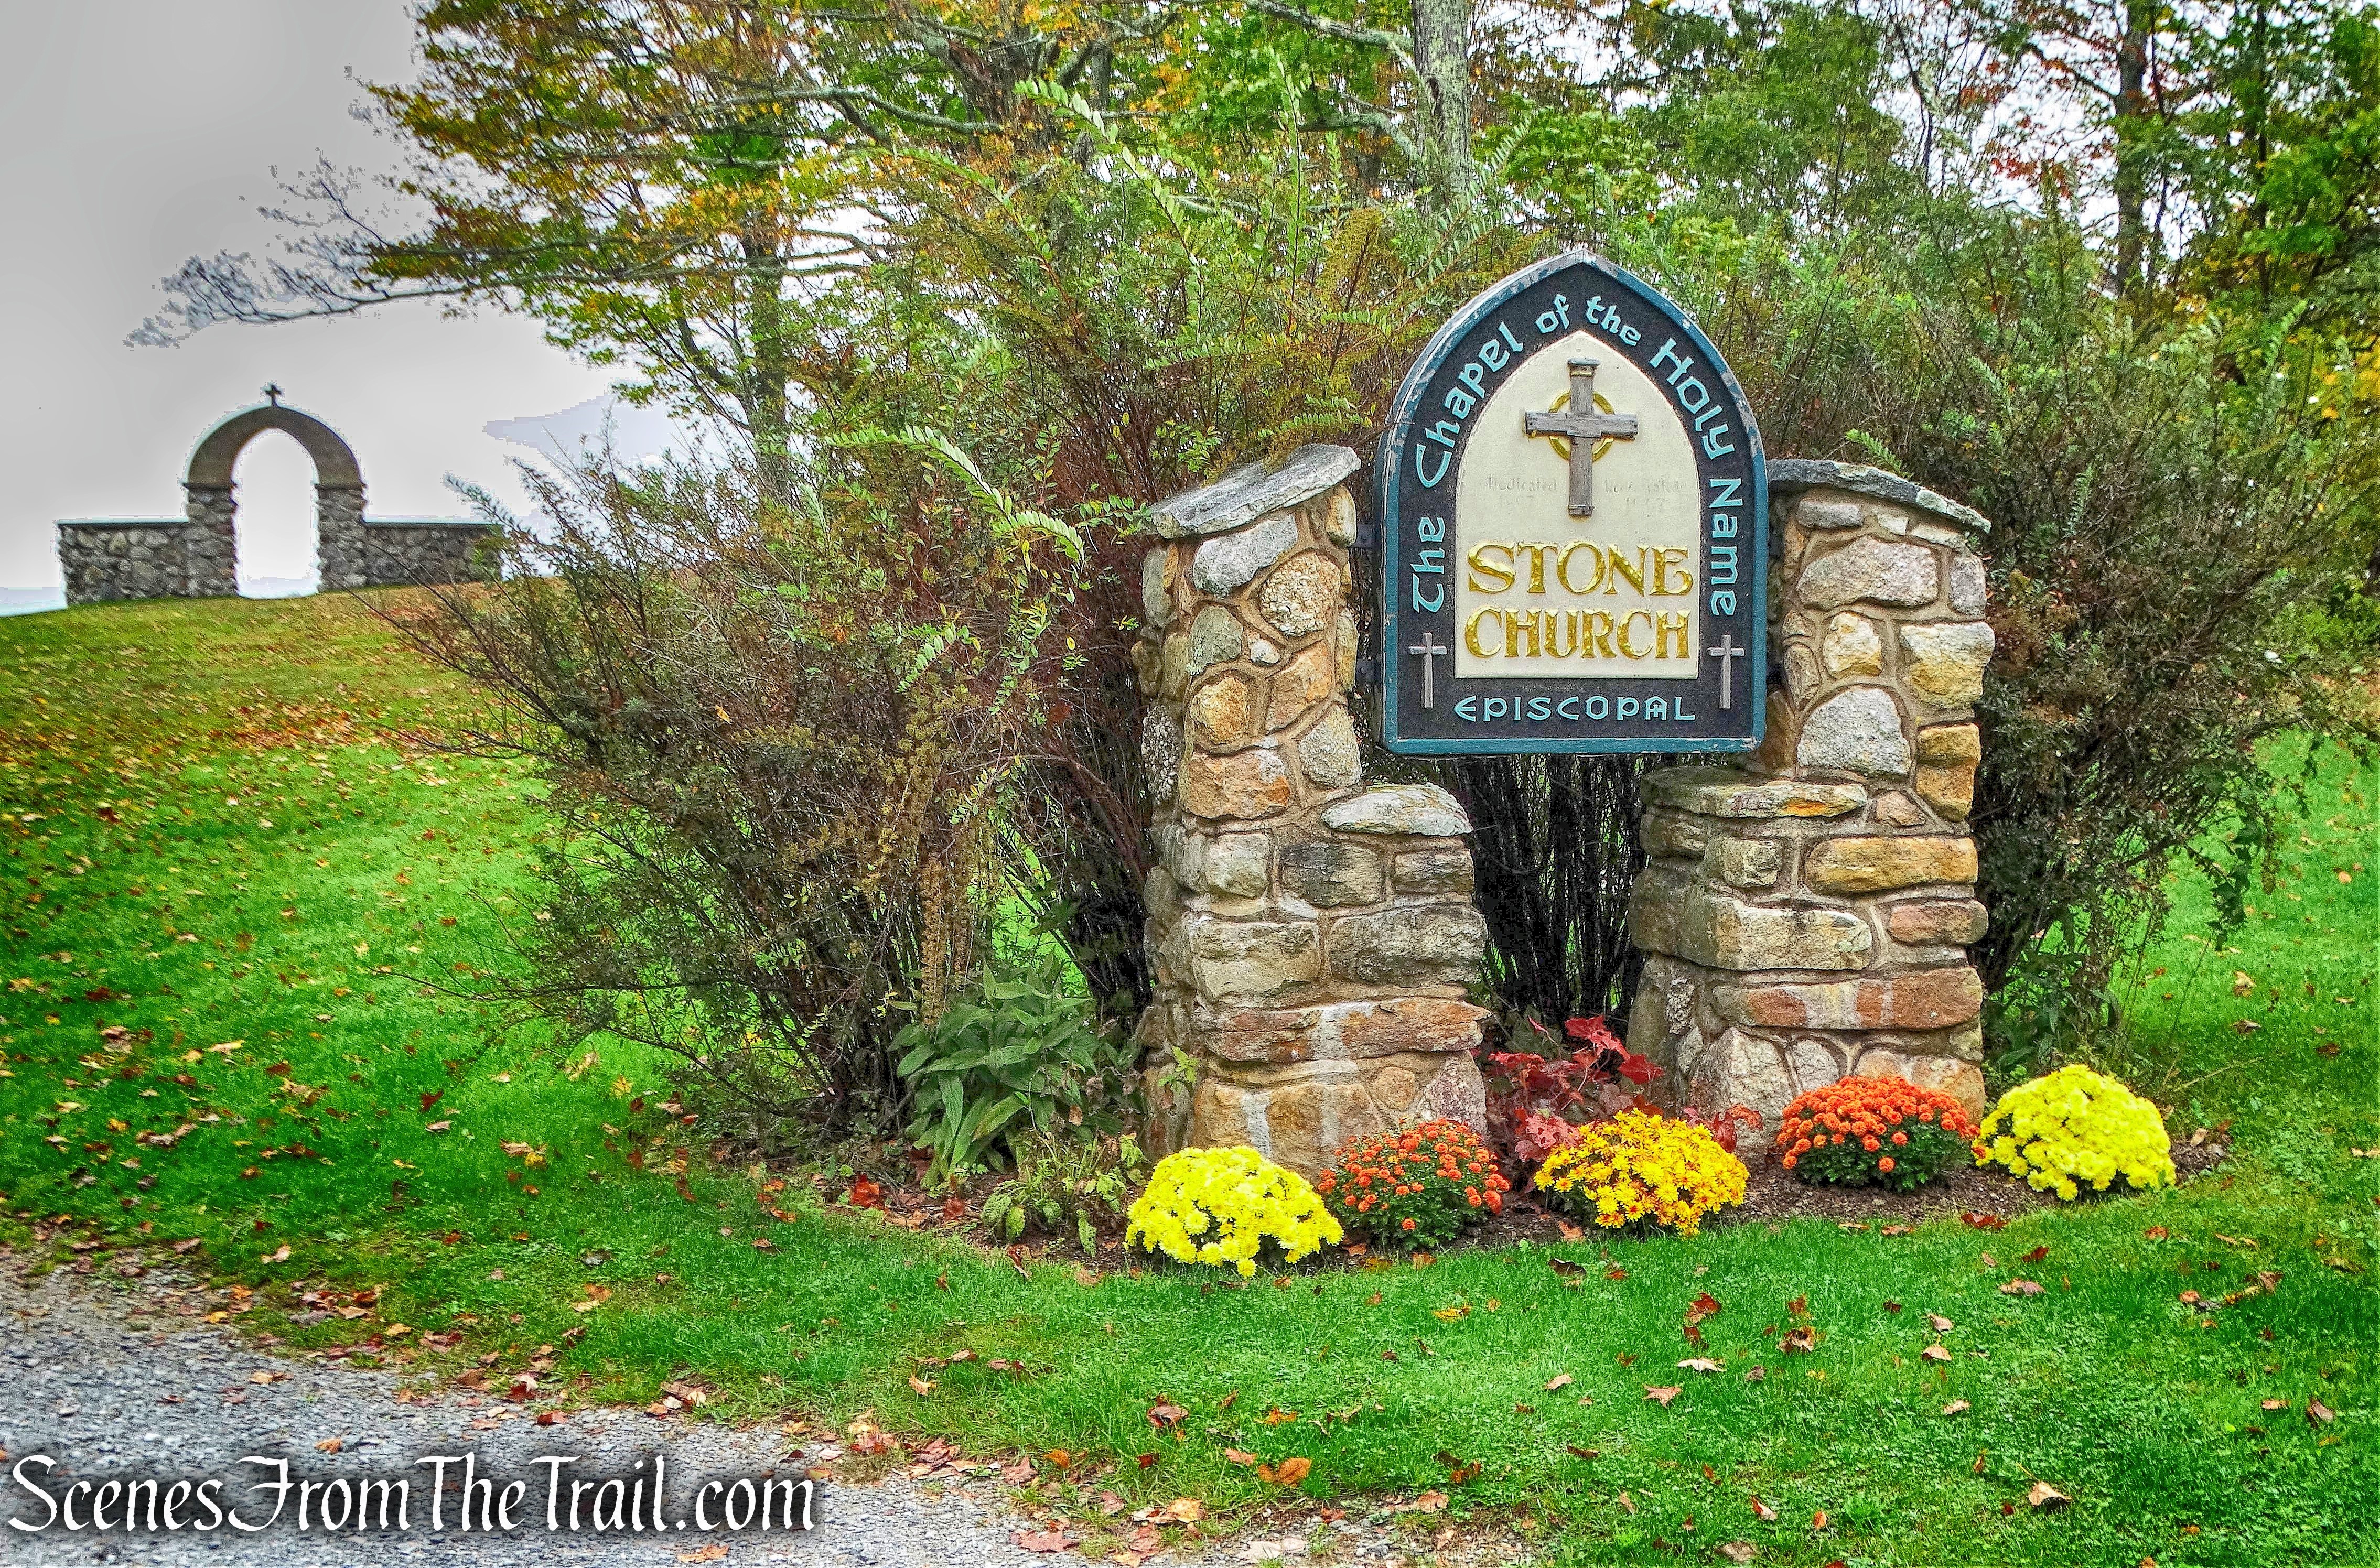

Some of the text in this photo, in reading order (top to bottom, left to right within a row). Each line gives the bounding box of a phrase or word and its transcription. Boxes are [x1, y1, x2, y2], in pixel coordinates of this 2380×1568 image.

[1410, 293, 1743, 617] The Chapel of the Holy Name
[1467, 542, 1694, 597] STONE
[1464, 607, 1691, 660] CHURCH
[1453, 695, 1696, 722] EPISCOPAL
